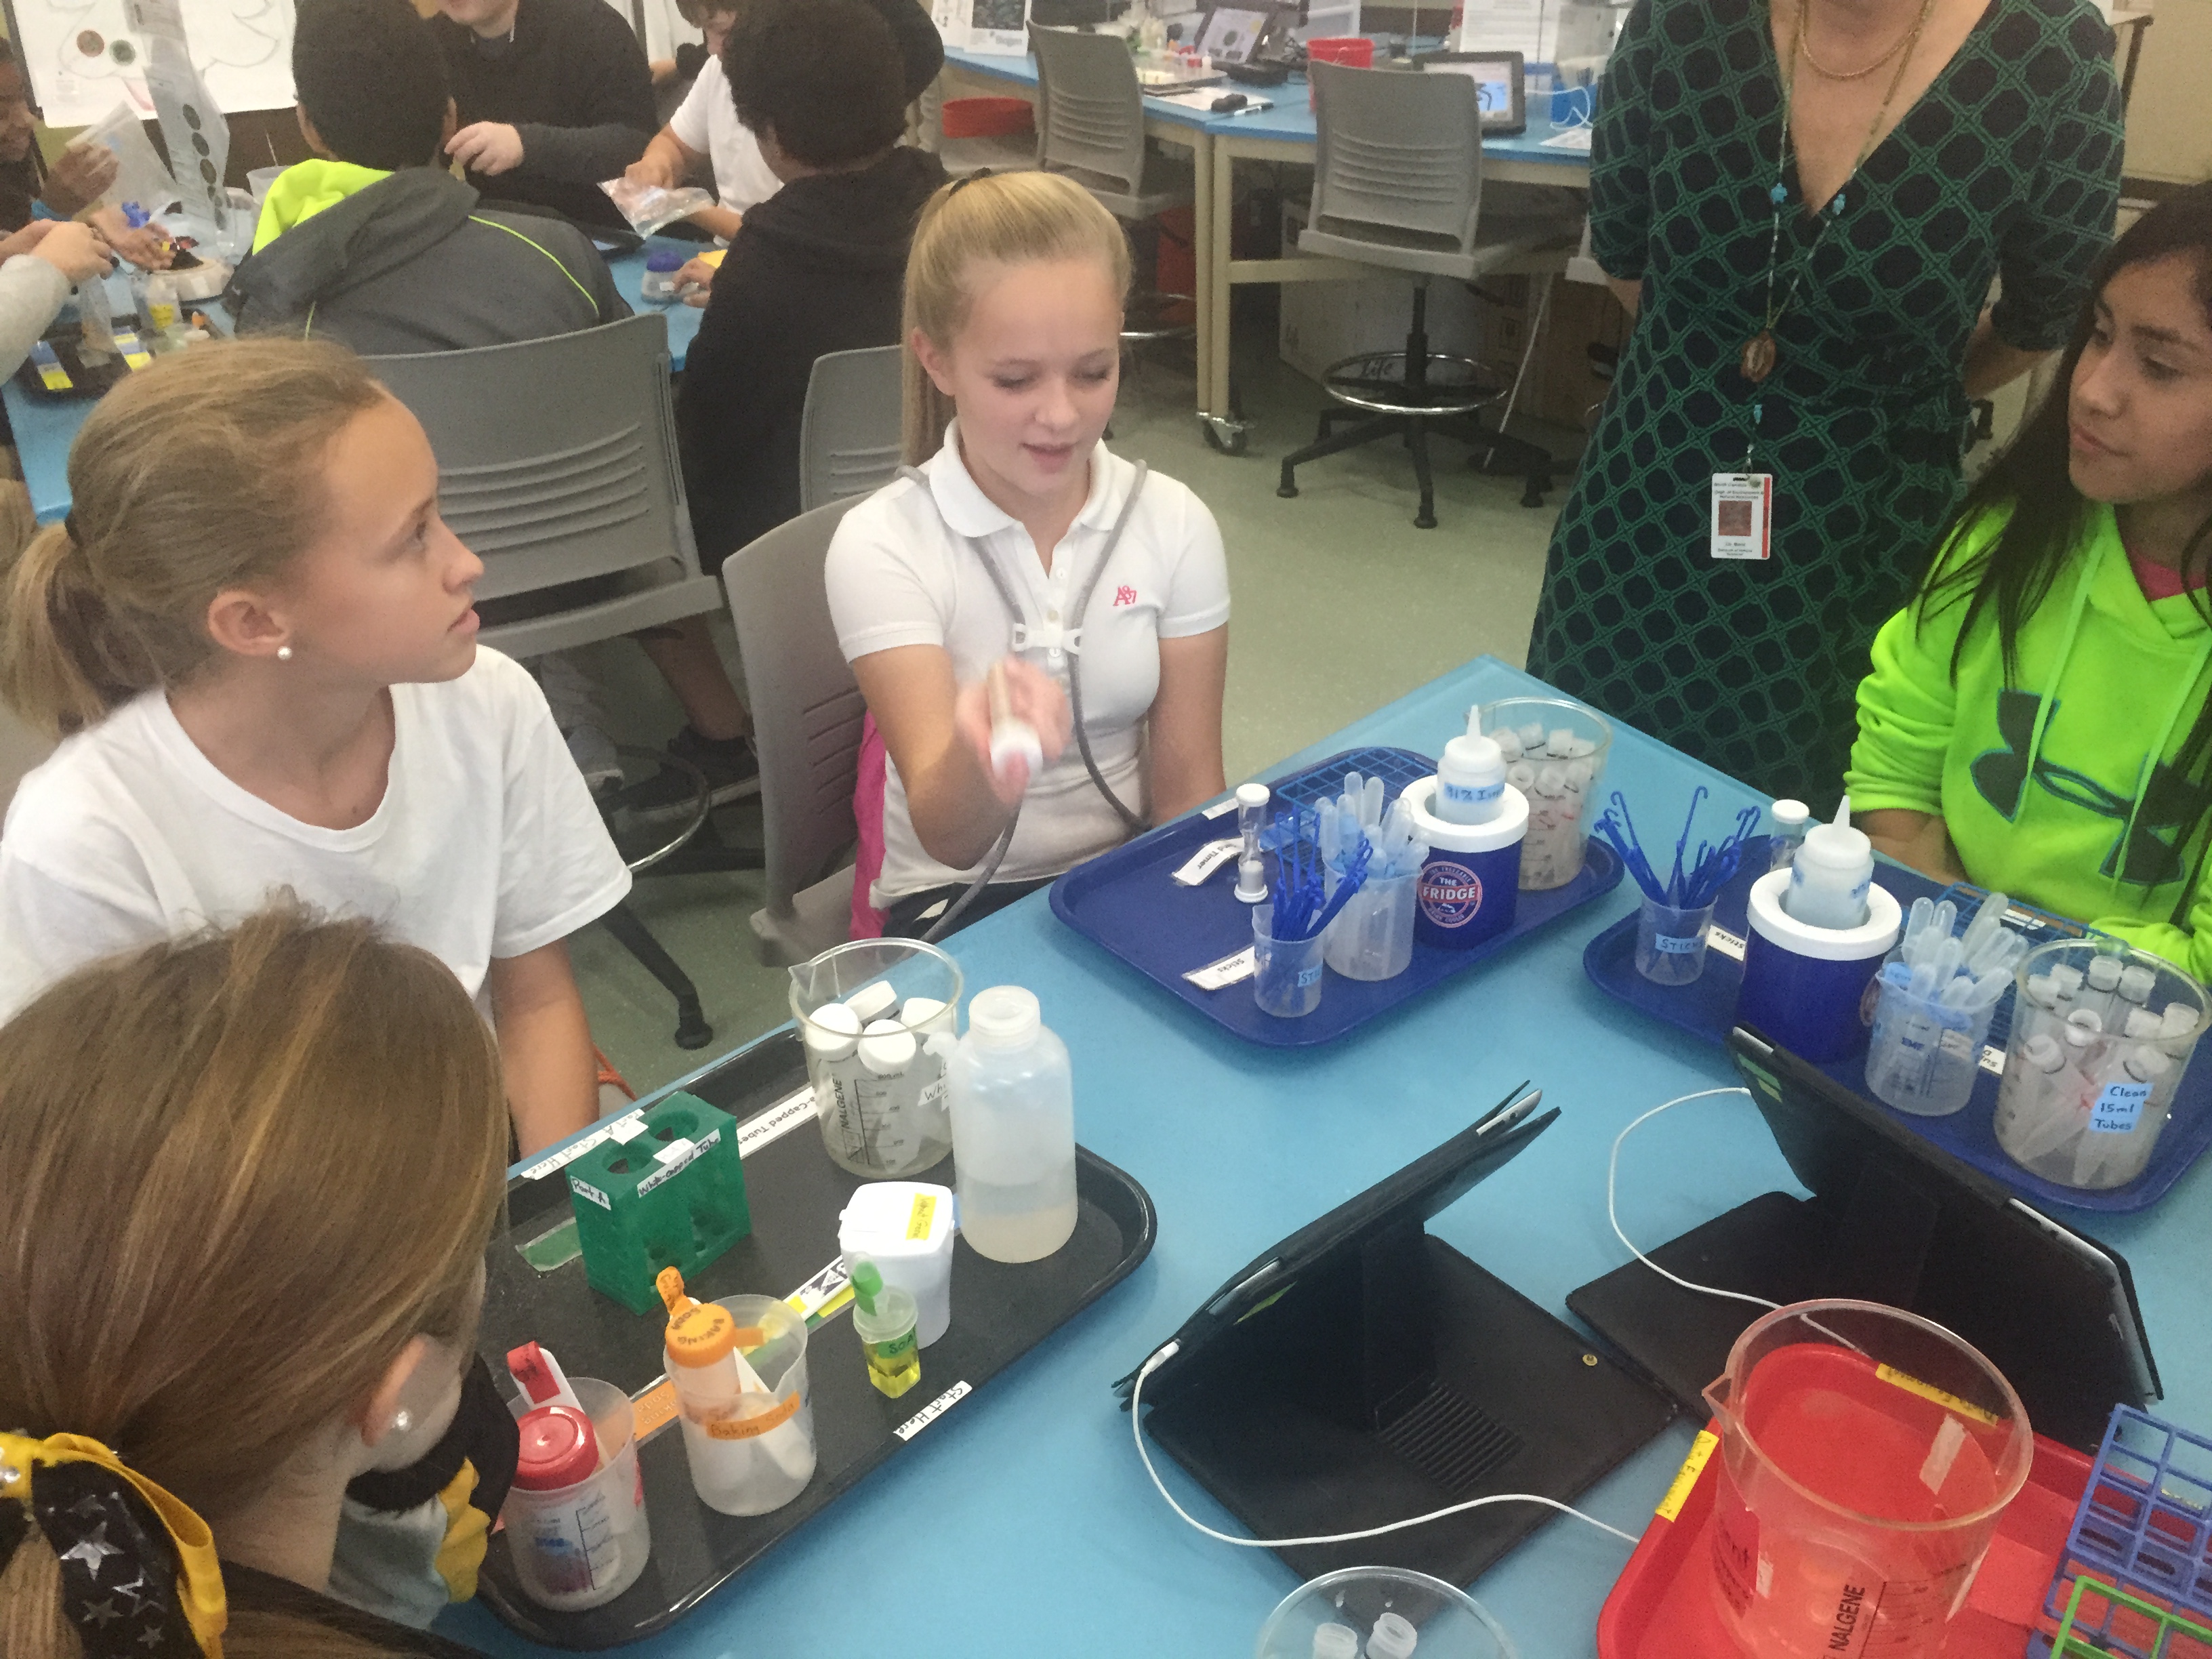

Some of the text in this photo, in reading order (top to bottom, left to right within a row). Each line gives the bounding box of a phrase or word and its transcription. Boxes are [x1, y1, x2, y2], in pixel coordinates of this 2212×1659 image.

[1197, 851, 1219, 870] Timer
[1439, 876, 1457, 886] THE
[1423, 886, 1476, 901] FRIDGE
[1217, 958, 1245, 973] Sticks
[2110, 1086, 2147, 1097] Clean
[832, 1078, 850, 1130] NALGENE
[2100, 1103, 2135, 1113] 15ml
[602, 1124, 614, 1136] A
[2094, 1118, 2132, 1130] Tubes
[738, 1125, 770, 1145] Tubes
[562, 1137, 597, 1161] Start
[530, 1157, 562, 1175] Here
[572, 1177, 595, 1198] Part
[711, 1403, 795, 1437] Baking Soda
[898, 1387, 963, 1435] Start Here
[1828, 1583, 1866, 1652] NALGENE
